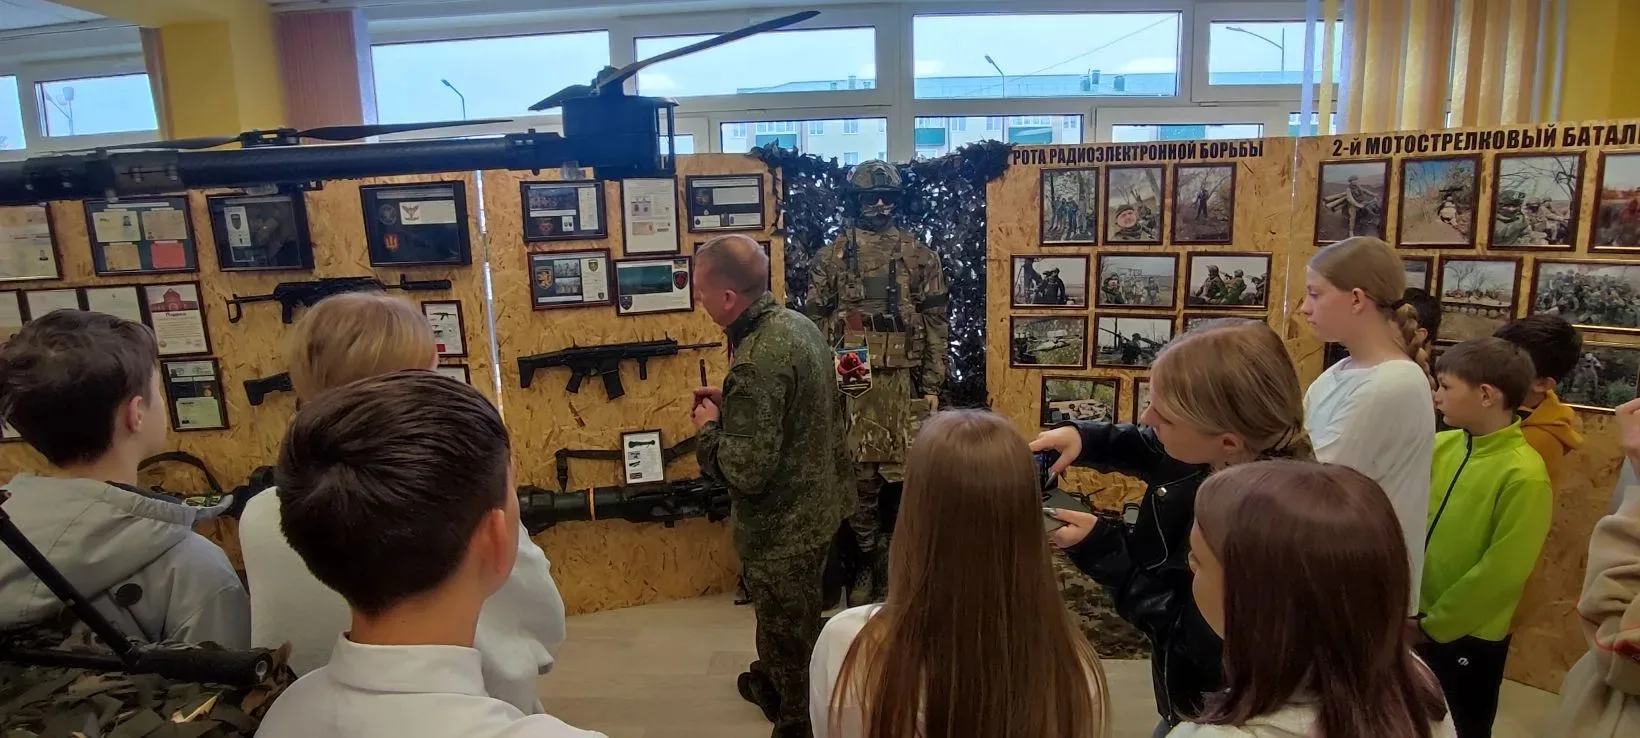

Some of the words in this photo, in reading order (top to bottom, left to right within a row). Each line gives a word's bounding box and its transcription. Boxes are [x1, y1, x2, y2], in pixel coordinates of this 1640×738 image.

[1013, 149, 1047, 165] РОТА
[1050, 140, 1196, 166] РАДИОЭЛЕКТРОННОЙ
[1200, 141, 1263, 159] БОРЬБЫ
[1332, 137, 1361, 157] 2-й
[1365, 124, 1557, 156] МОТОСТРЕЛКОВЫЙ
[1562, 124, 1640, 147] БАТАЛ
